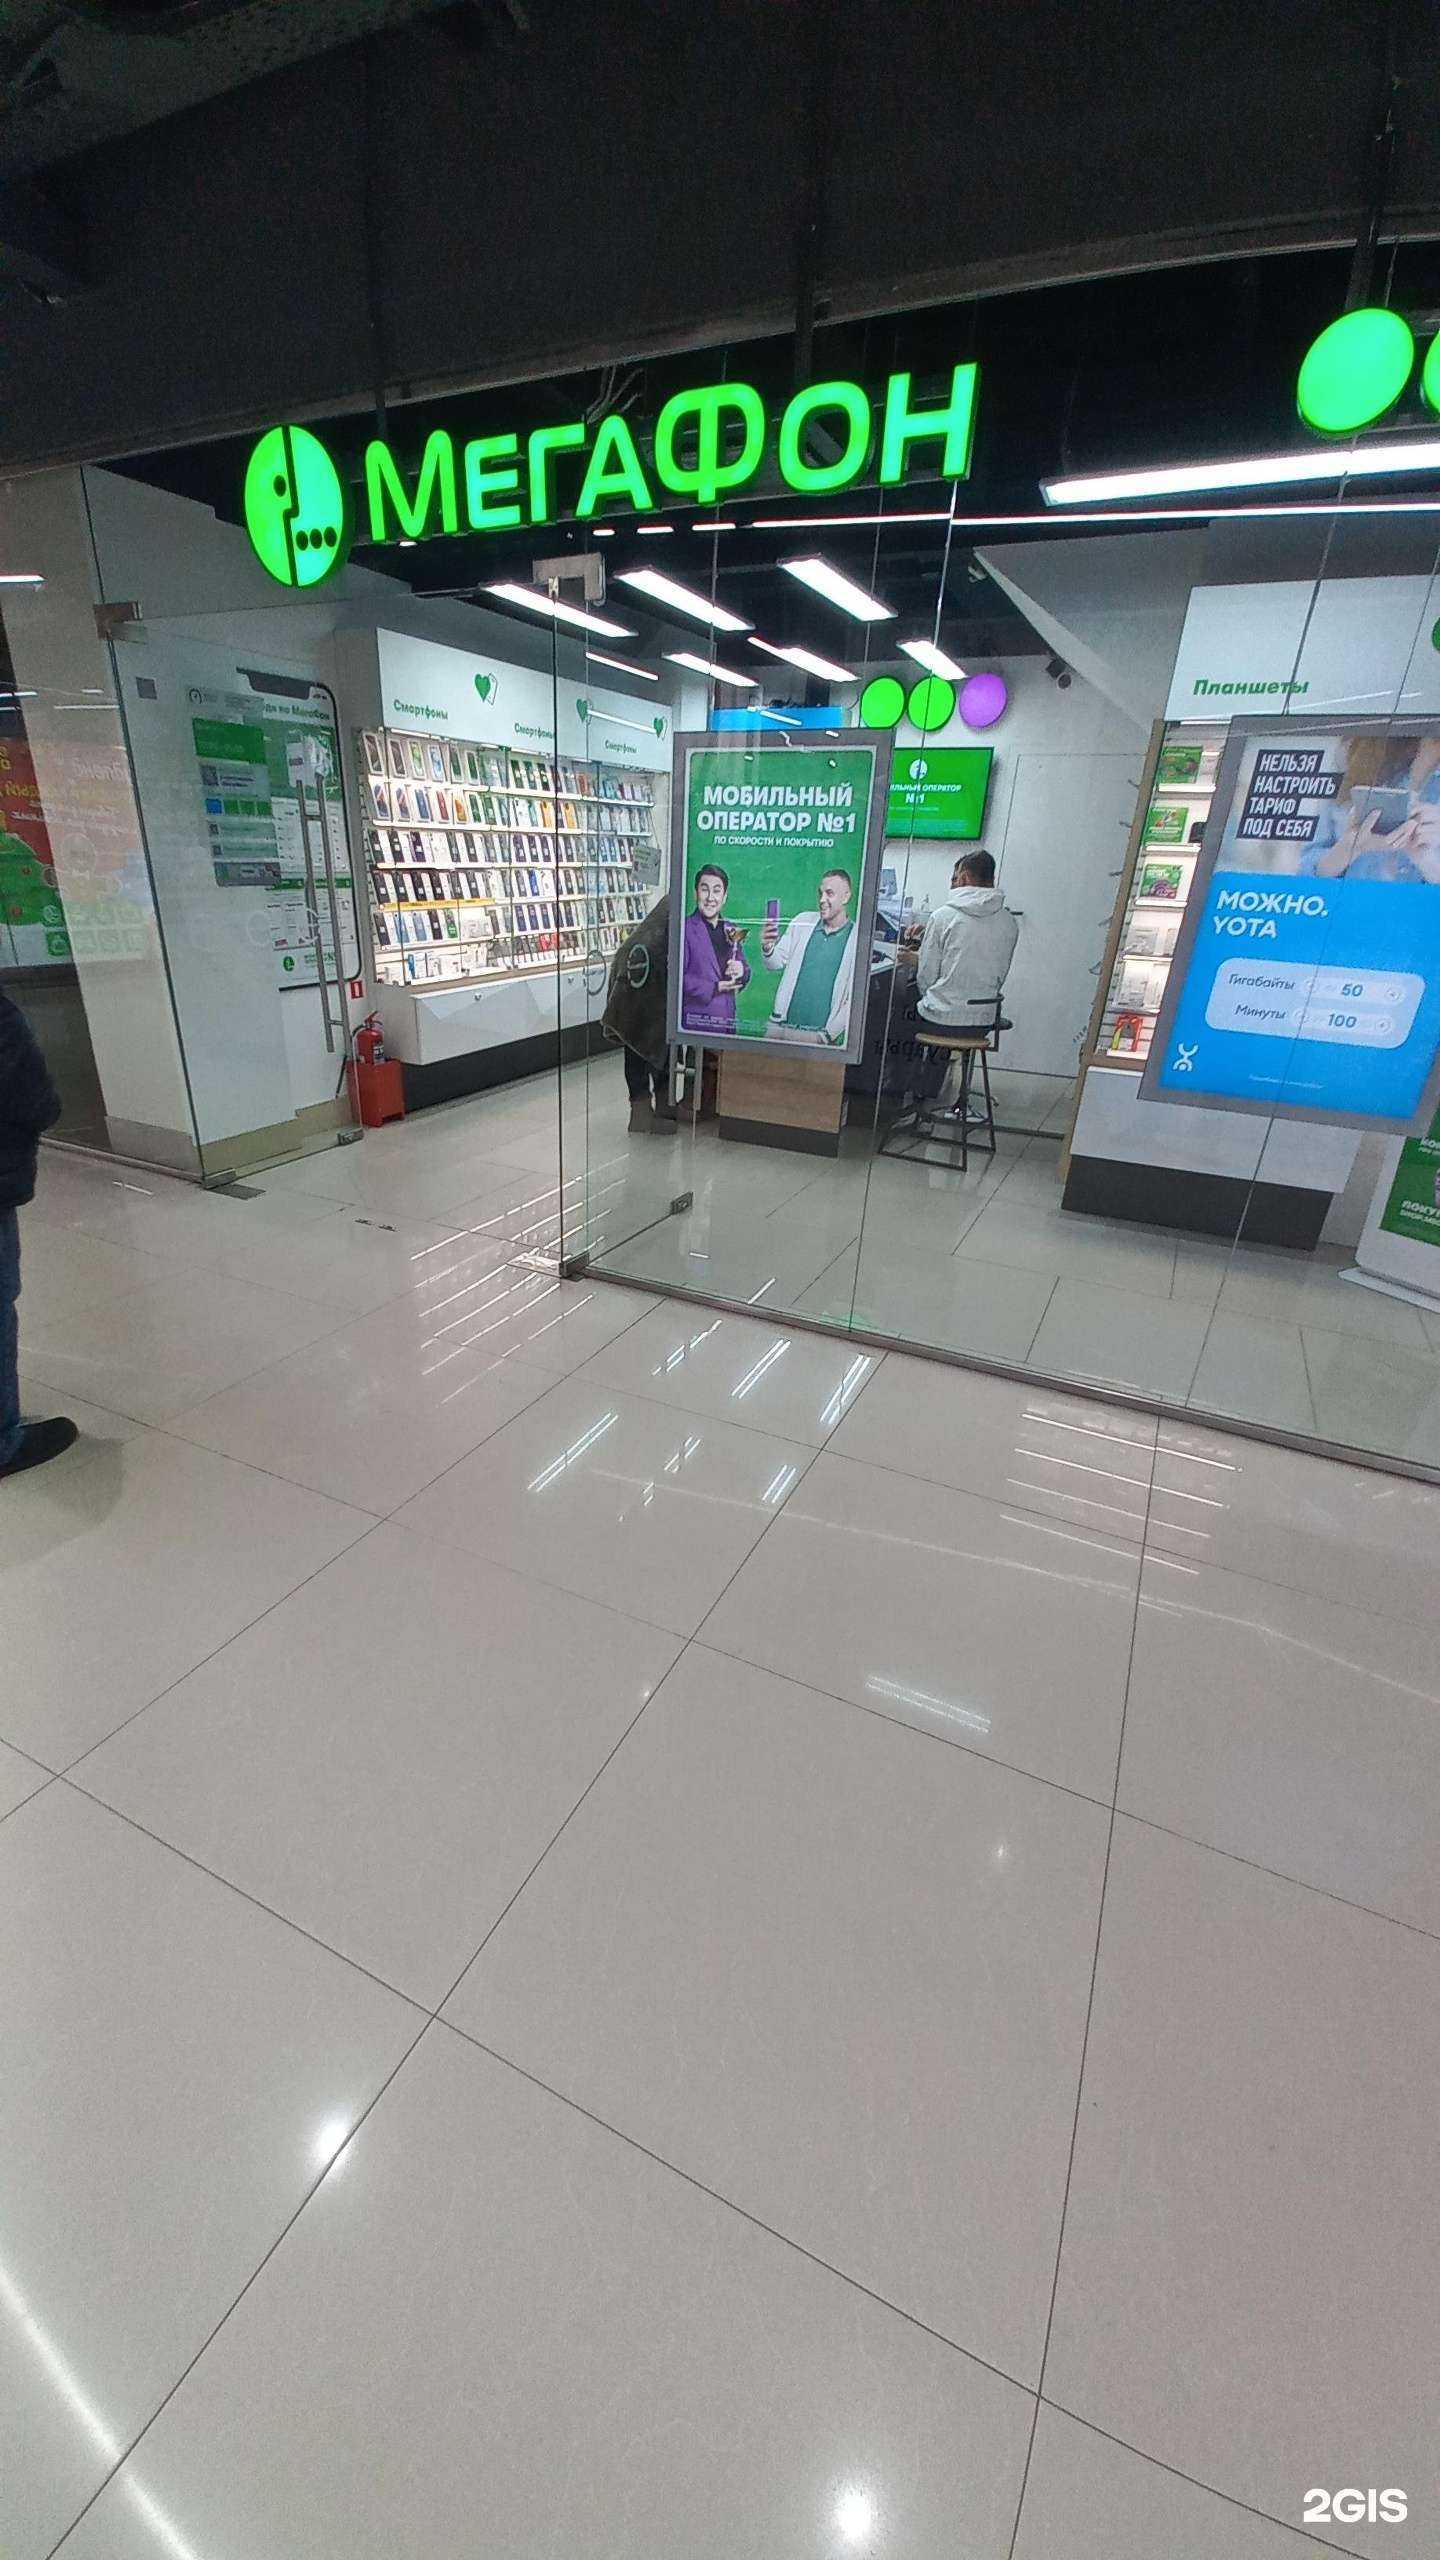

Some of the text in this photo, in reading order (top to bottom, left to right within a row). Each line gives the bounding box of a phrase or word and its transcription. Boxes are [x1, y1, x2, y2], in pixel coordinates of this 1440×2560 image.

[1193, 679, 1310, 695] Планшеты
[393, 699, 448, 720] Смартфоны
[605, 739, 637, 754] Смартфоны
[1260, 753, 1318, 773] НЕЛЬЗЯ
[704, 781, 853, 807] МОБИЛЬНЫЙ
[922, 784, 962, 793] ОПЕРАТОР
[1254, 776, 1337, 795] НАСТРОИТЬ
[1249, 798, 1297, 816] ТАРИФ
[697, 809, 857, 833] ОПЕРАТОР №1
[1242, 817, 1313, 838] ПОД СЕБЯ
[714, 835, 834, 848] ПО СКОРОСТИ И ПОКРЫТИЮ
[1216, 889, 1329, 917] МОЖНО.
[1213, 915, 1278, 939] YOTA
[1228, 973, 1364, 997] Гигабайты 50
[1234, 1003, 1358, 1029] Минуты 100
